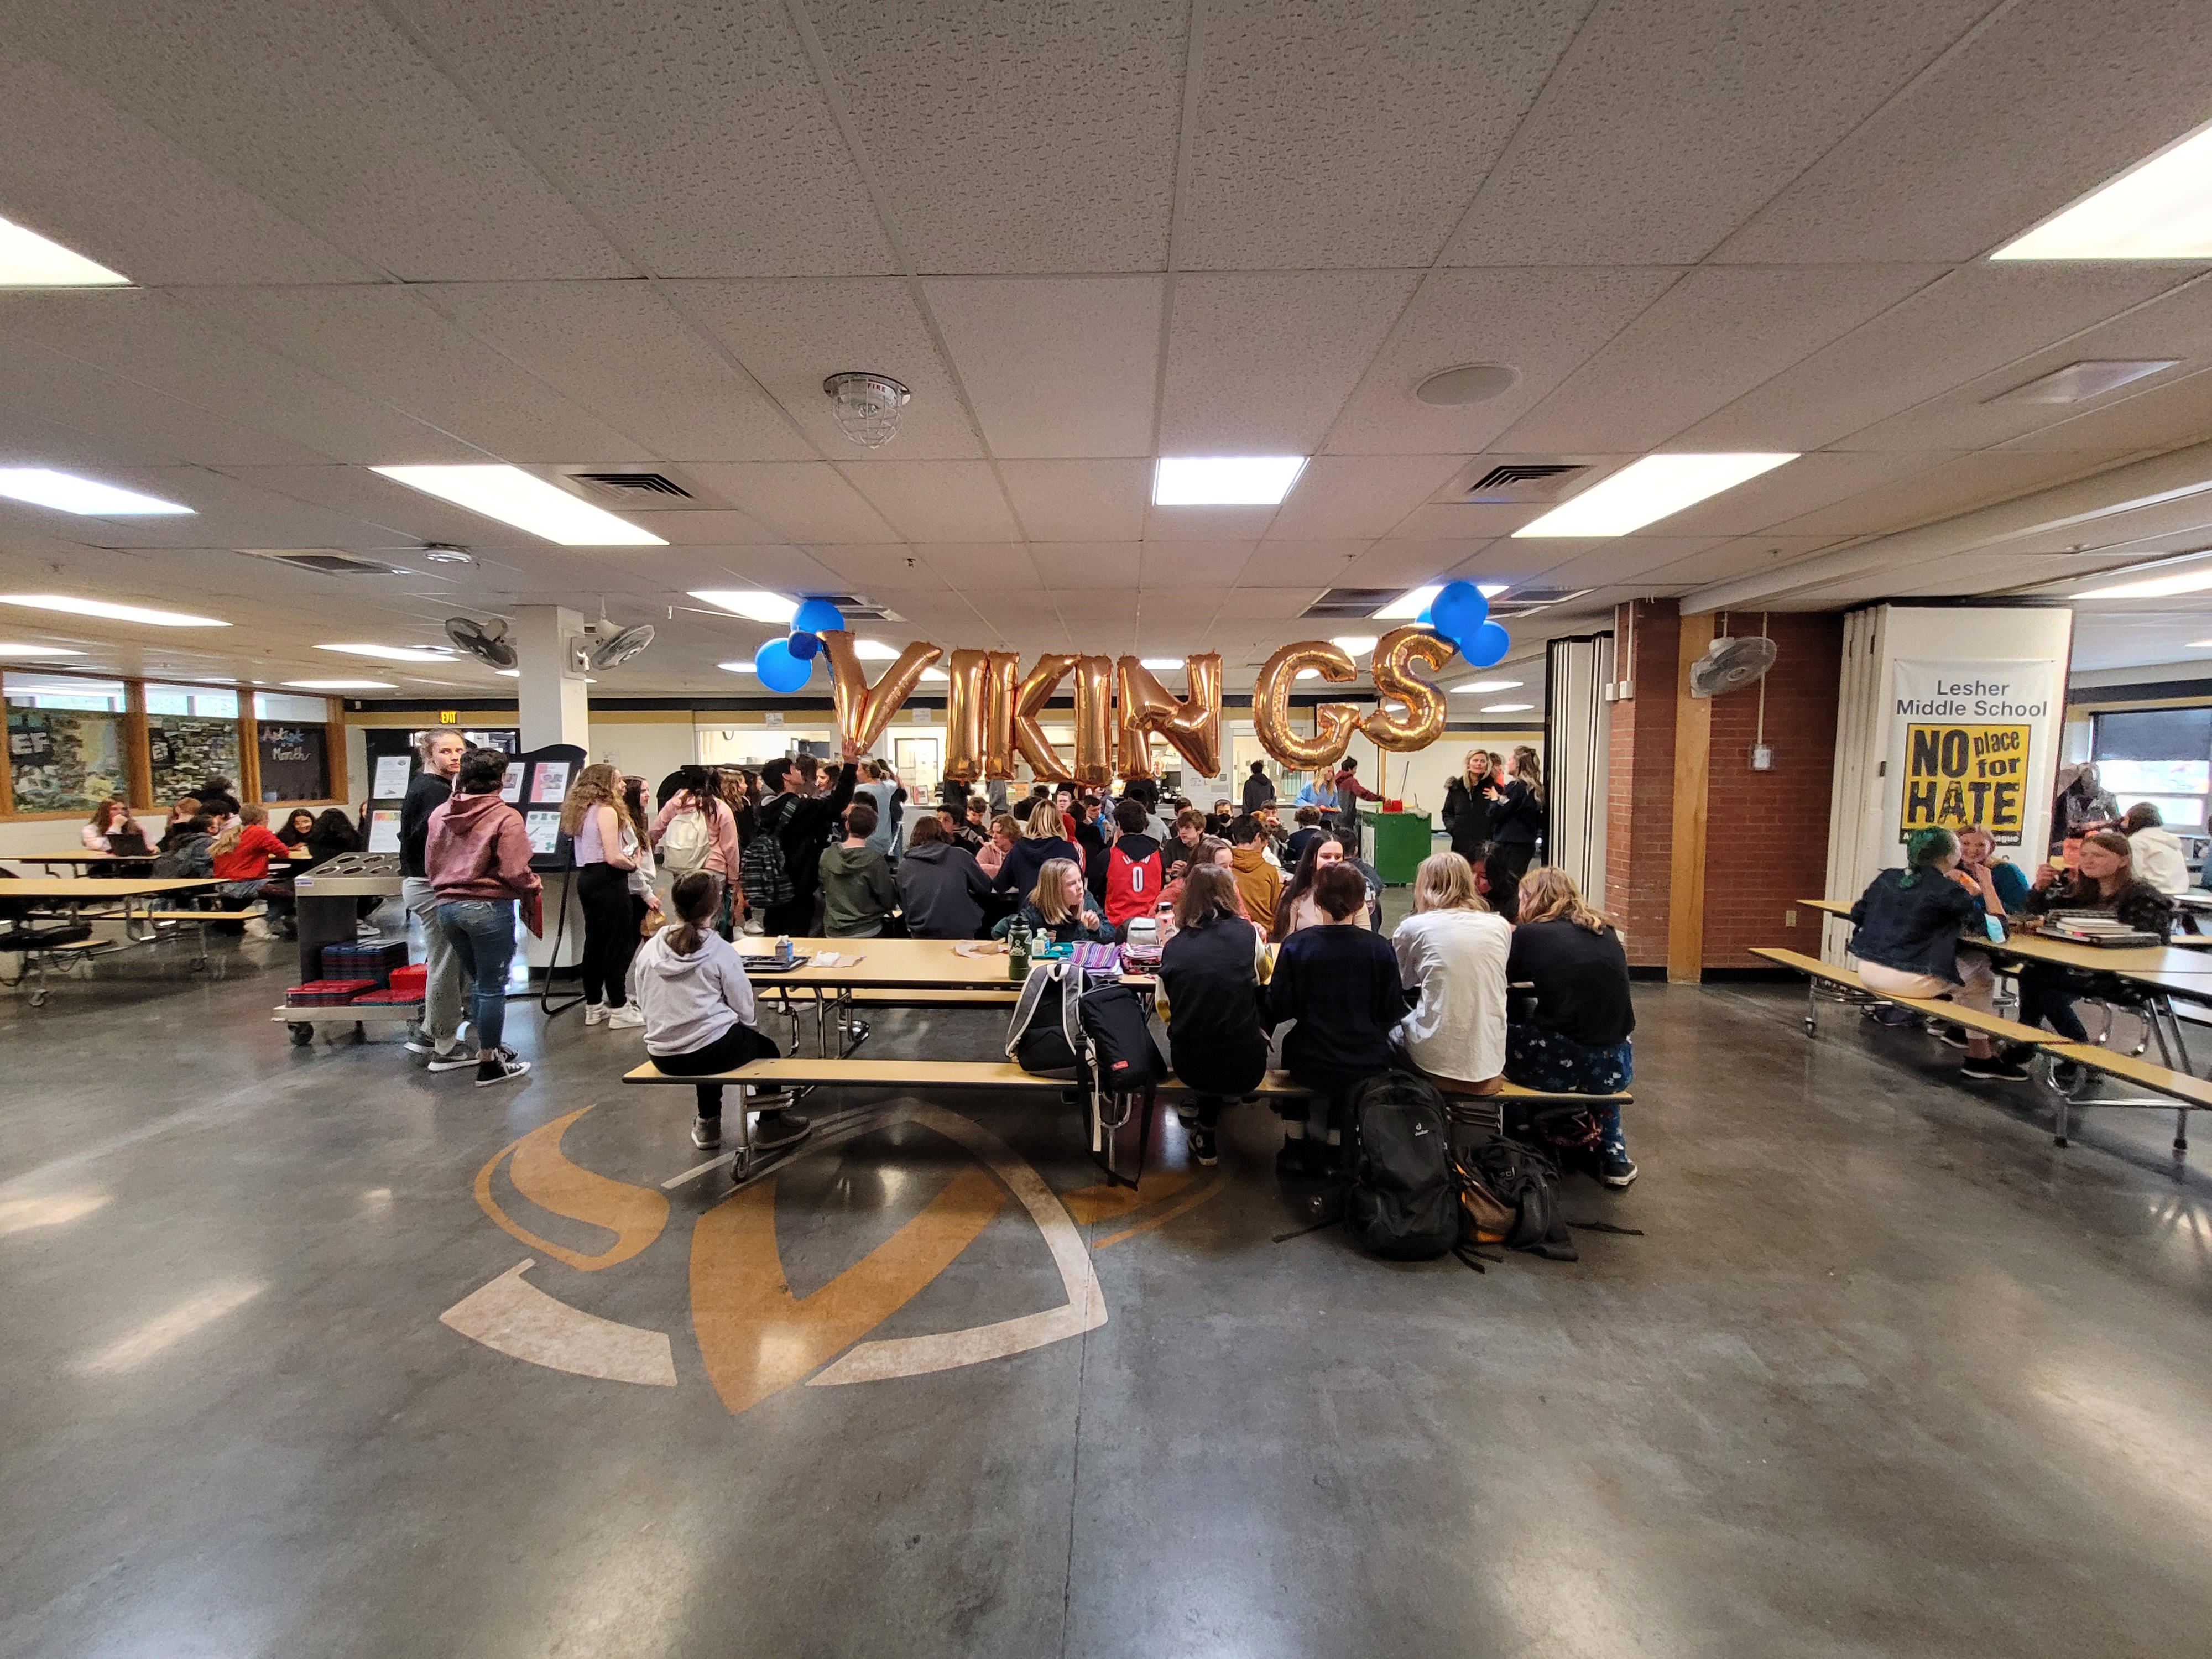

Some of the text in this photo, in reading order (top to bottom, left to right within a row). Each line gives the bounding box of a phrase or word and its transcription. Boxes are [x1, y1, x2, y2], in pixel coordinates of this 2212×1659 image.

[868, 383, 886, 393] FIRE
[1937, 680, 2010, 696] Lesher
[815, 623, 1460, 787] VIKINGS
[1896, 699, 2048, 717] Middle School
[441, 711, 457, 724] EXIT
[1911, 729, 2020, 779] NO place
[1976, 757, 2021, 779] for
[1907, 780, 2021, 825] HATE
[1133, 866, 1143, 893] 0
